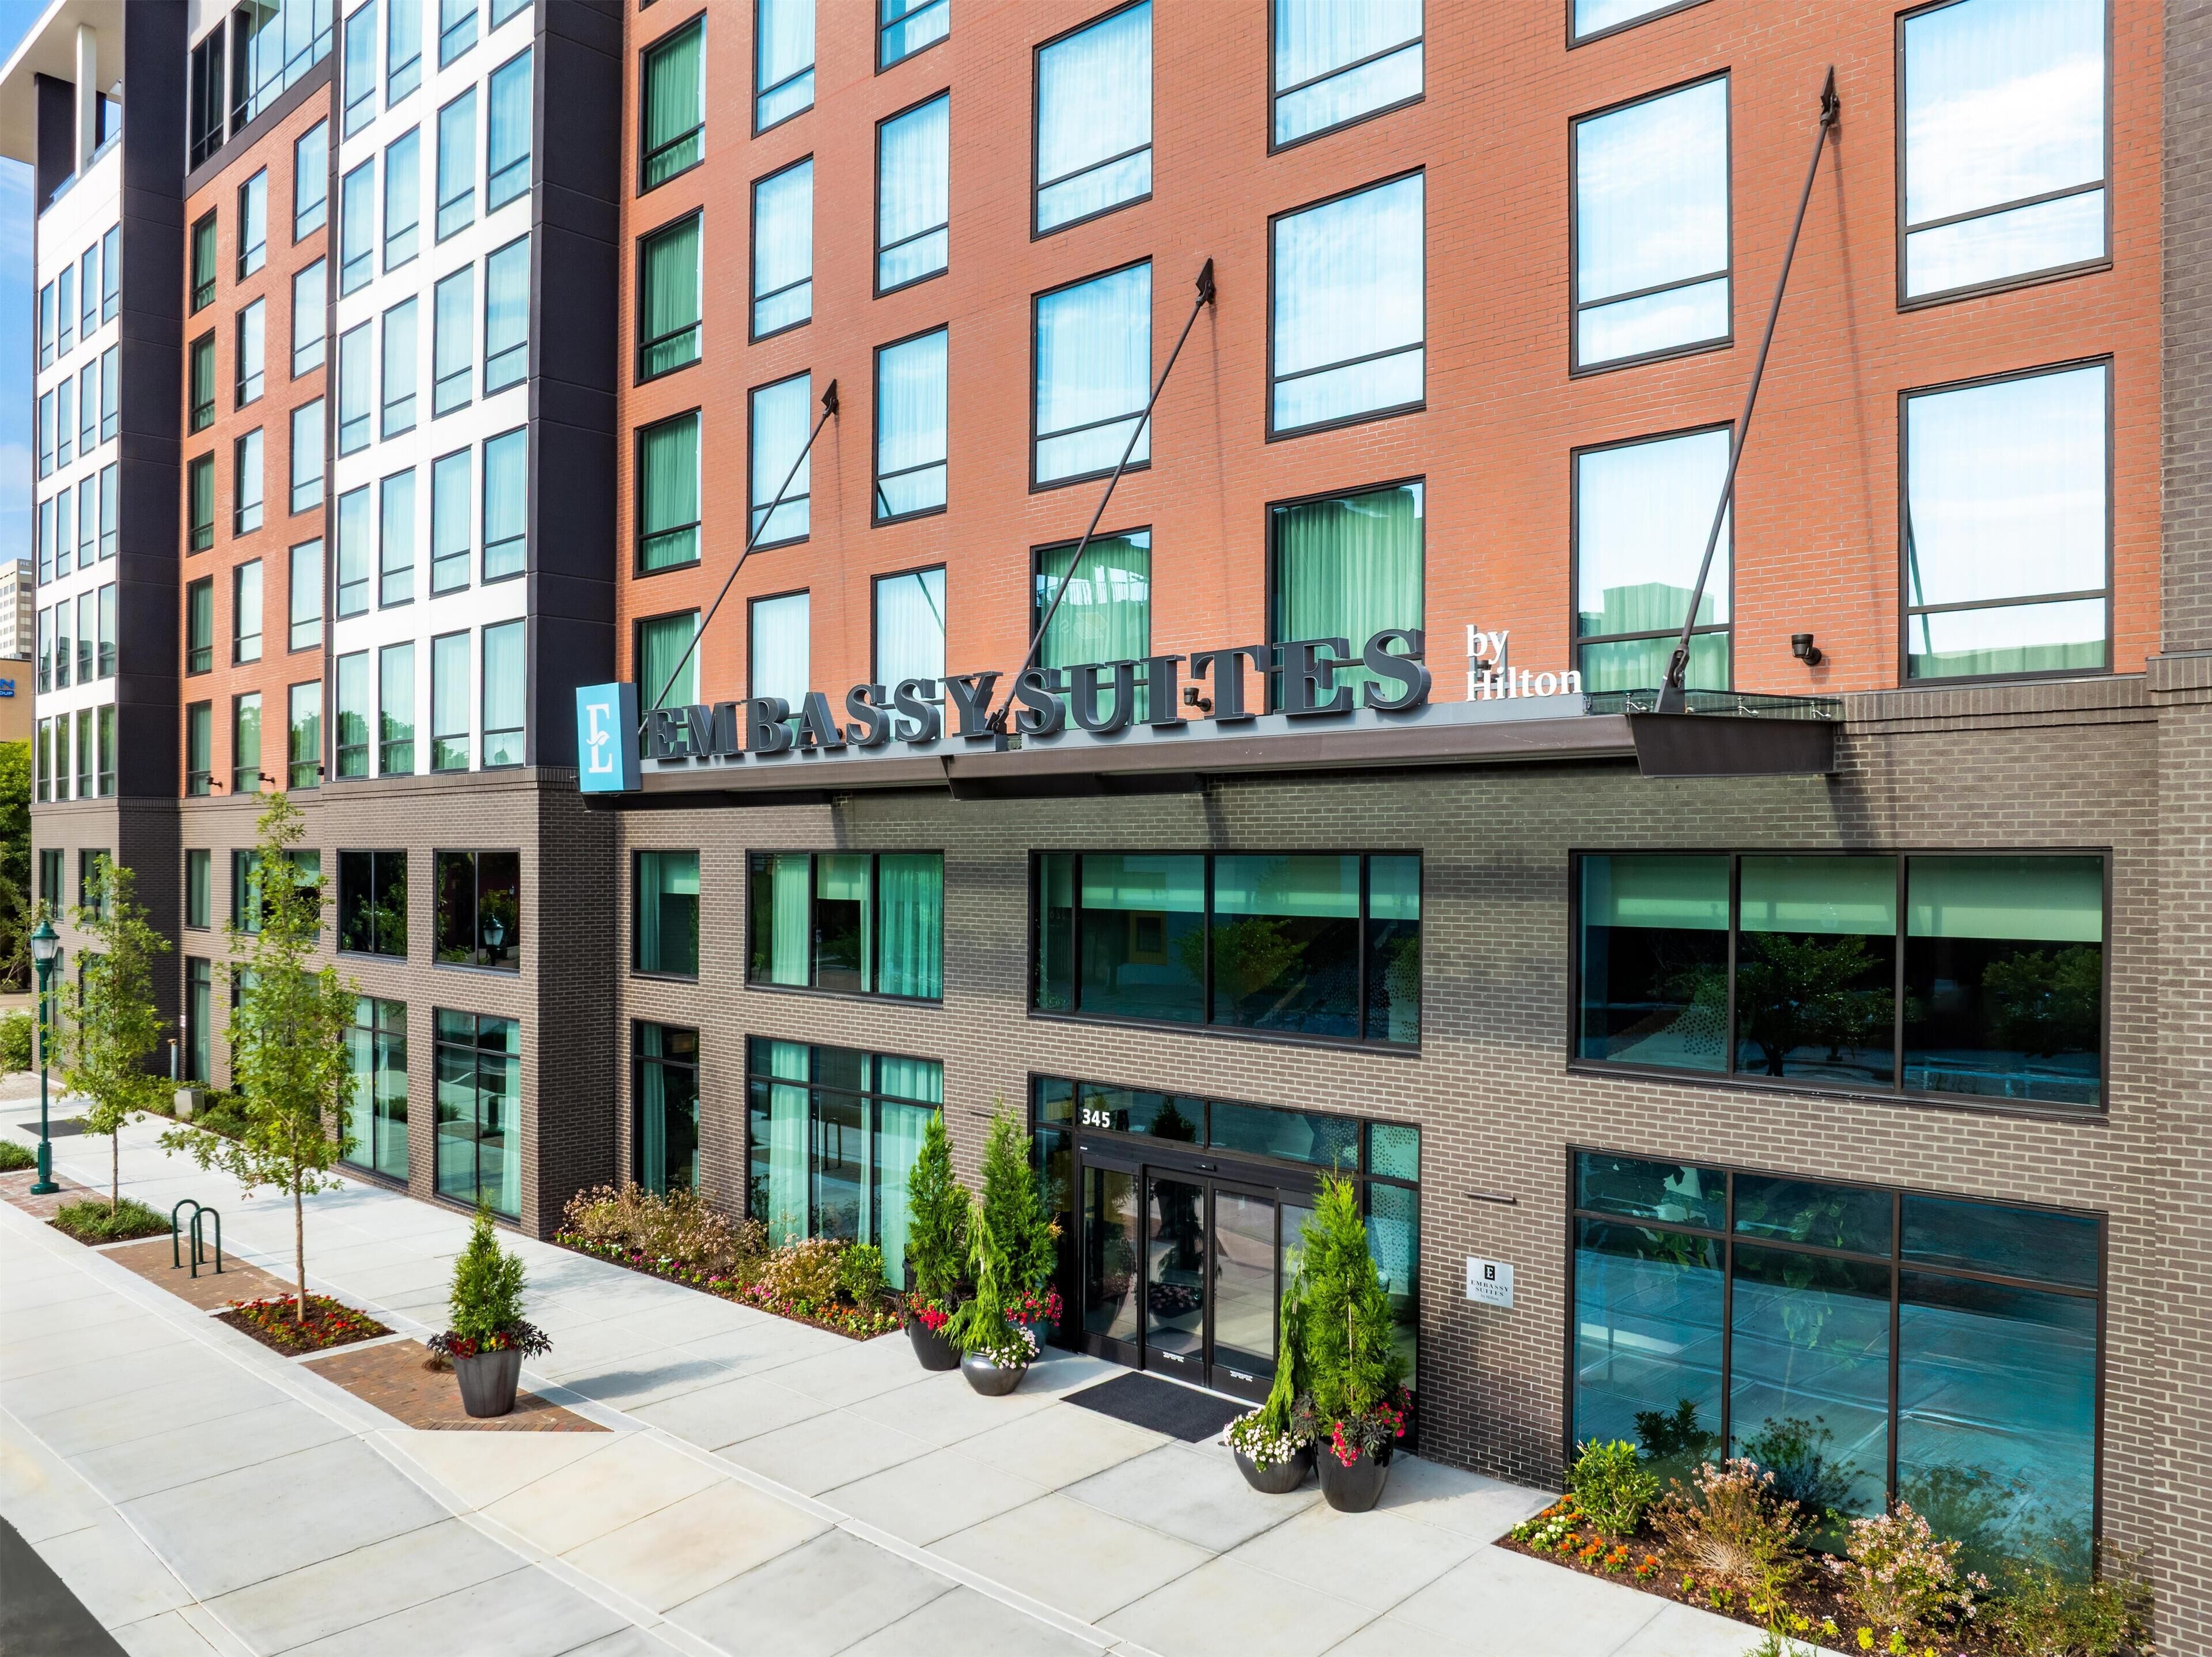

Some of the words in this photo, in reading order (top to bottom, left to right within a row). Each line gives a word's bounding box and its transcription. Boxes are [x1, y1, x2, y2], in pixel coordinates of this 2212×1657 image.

[1466, 624, 1510, 665] by
[642, 671, 1003, 759] EMBASSY
[1015, 628, 1431, 735] SUITES
[1465, 666, 1583, 702] Hilton
[1082, 1108, 1110, 1128] 345
[1471, 1280, 1509, 1292] EMBASSY
[1475, 1287, 1504, 1296] SUITES
